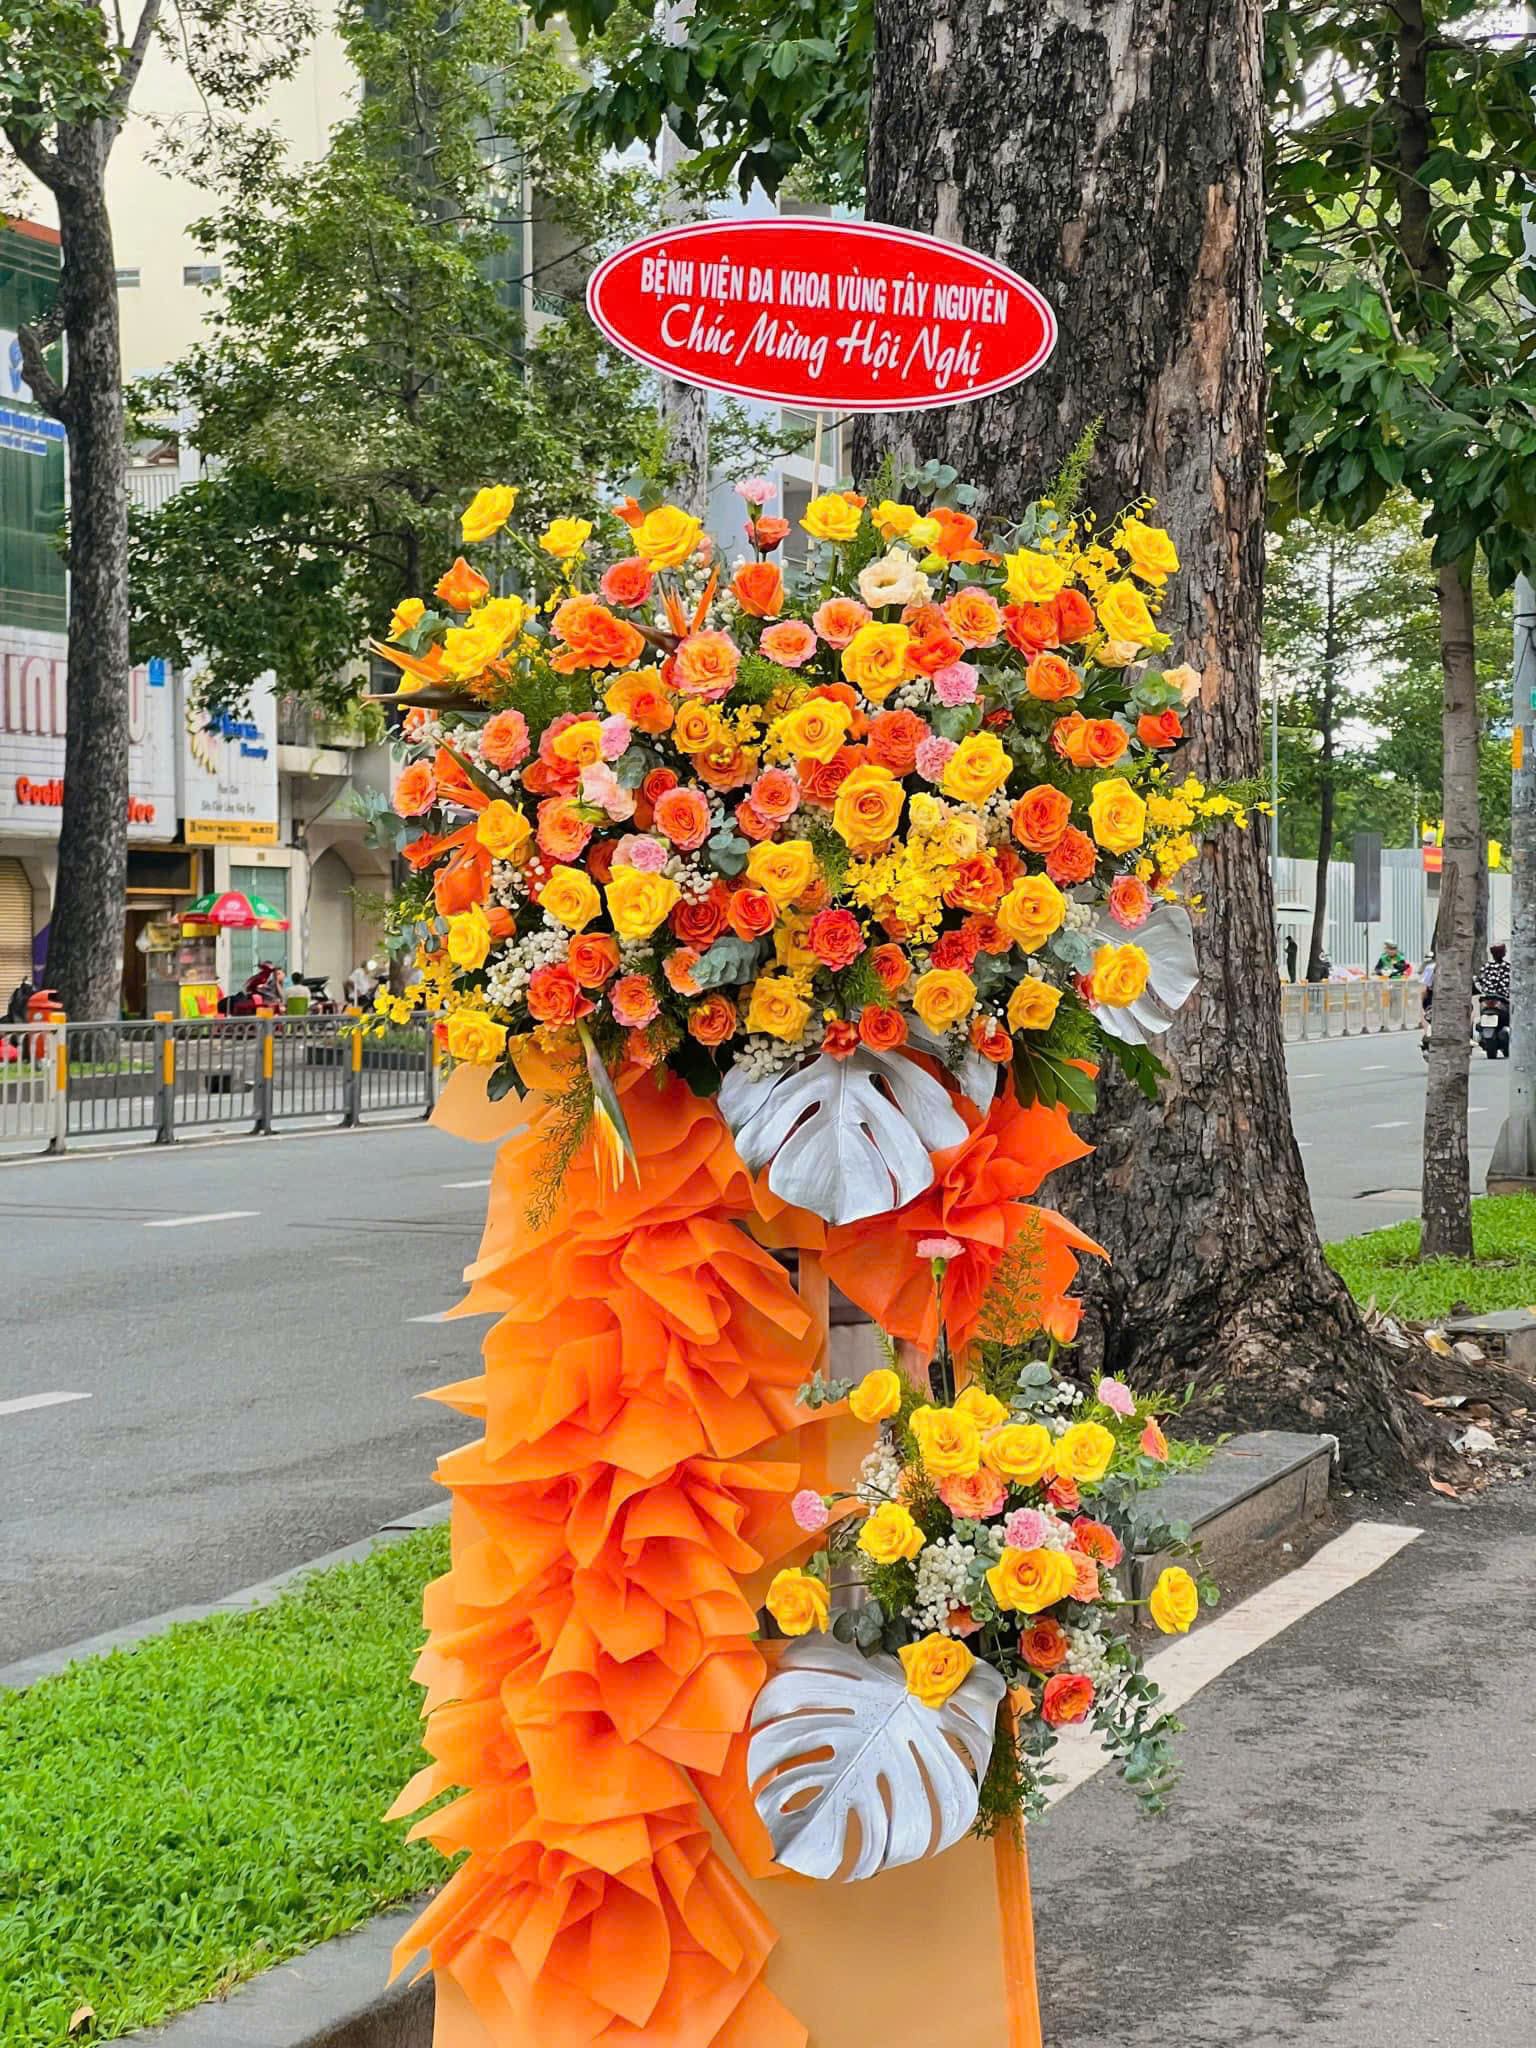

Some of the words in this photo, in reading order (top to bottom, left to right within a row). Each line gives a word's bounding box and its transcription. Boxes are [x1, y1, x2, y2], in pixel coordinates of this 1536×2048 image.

[640, 249, 695, 302] BỆNH
[699, 255, 745, 307] VIỆN
[748, 266, 774, 304] ĐA
[779, 269, 831, 309] KHOA
[836, 265, 888, 315] VÙNG
[892, 271, 929, 318] TÂY
[932, 278, 1009, 325] NGUYÊN
[660, 302, 736, 355] Chúc
[735, 310, 829, 379] Mừng
[835, 319, 902, 381] Hội
[901, 323, 983, 389] Nghị
